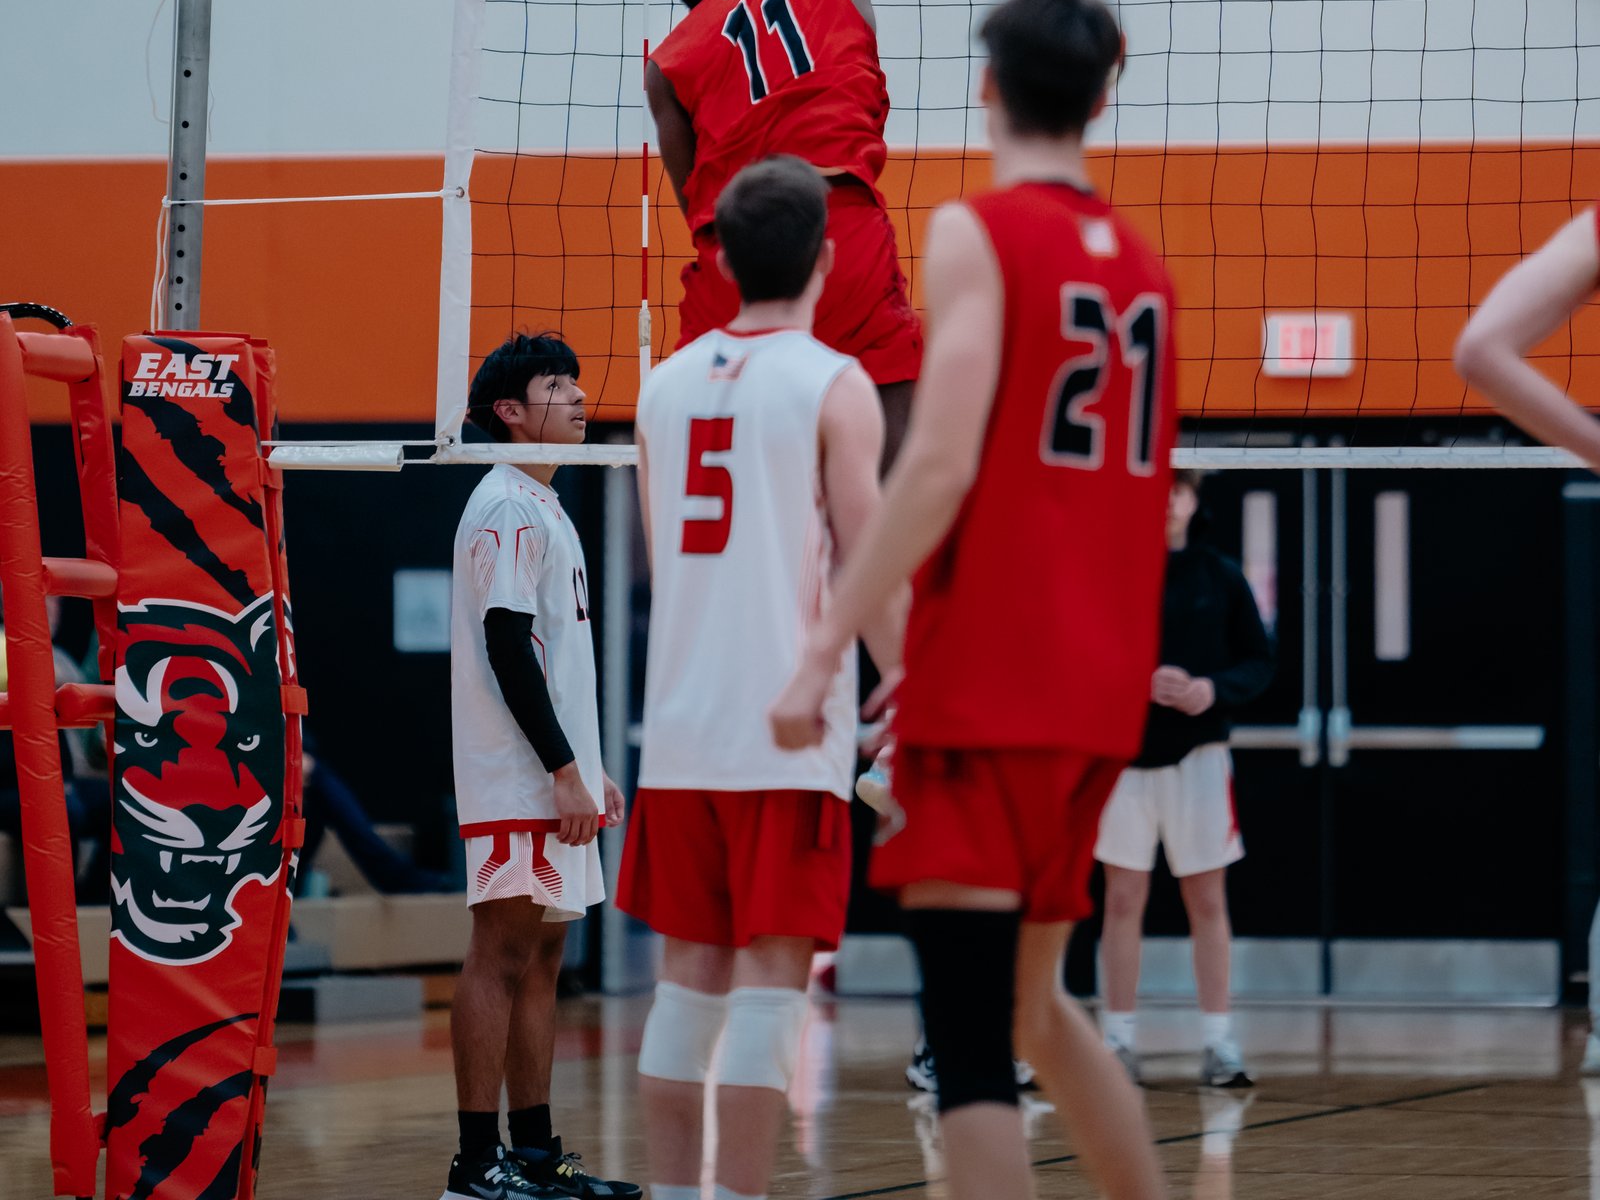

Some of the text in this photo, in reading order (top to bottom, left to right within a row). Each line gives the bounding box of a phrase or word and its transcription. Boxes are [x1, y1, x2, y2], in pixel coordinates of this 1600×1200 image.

[128, 382, 235, 398] BENGALS
[133, 353, 239, 380] EAST
[1039, 281, 1166, 477] 21
[680, 417, 734, 555] 5
